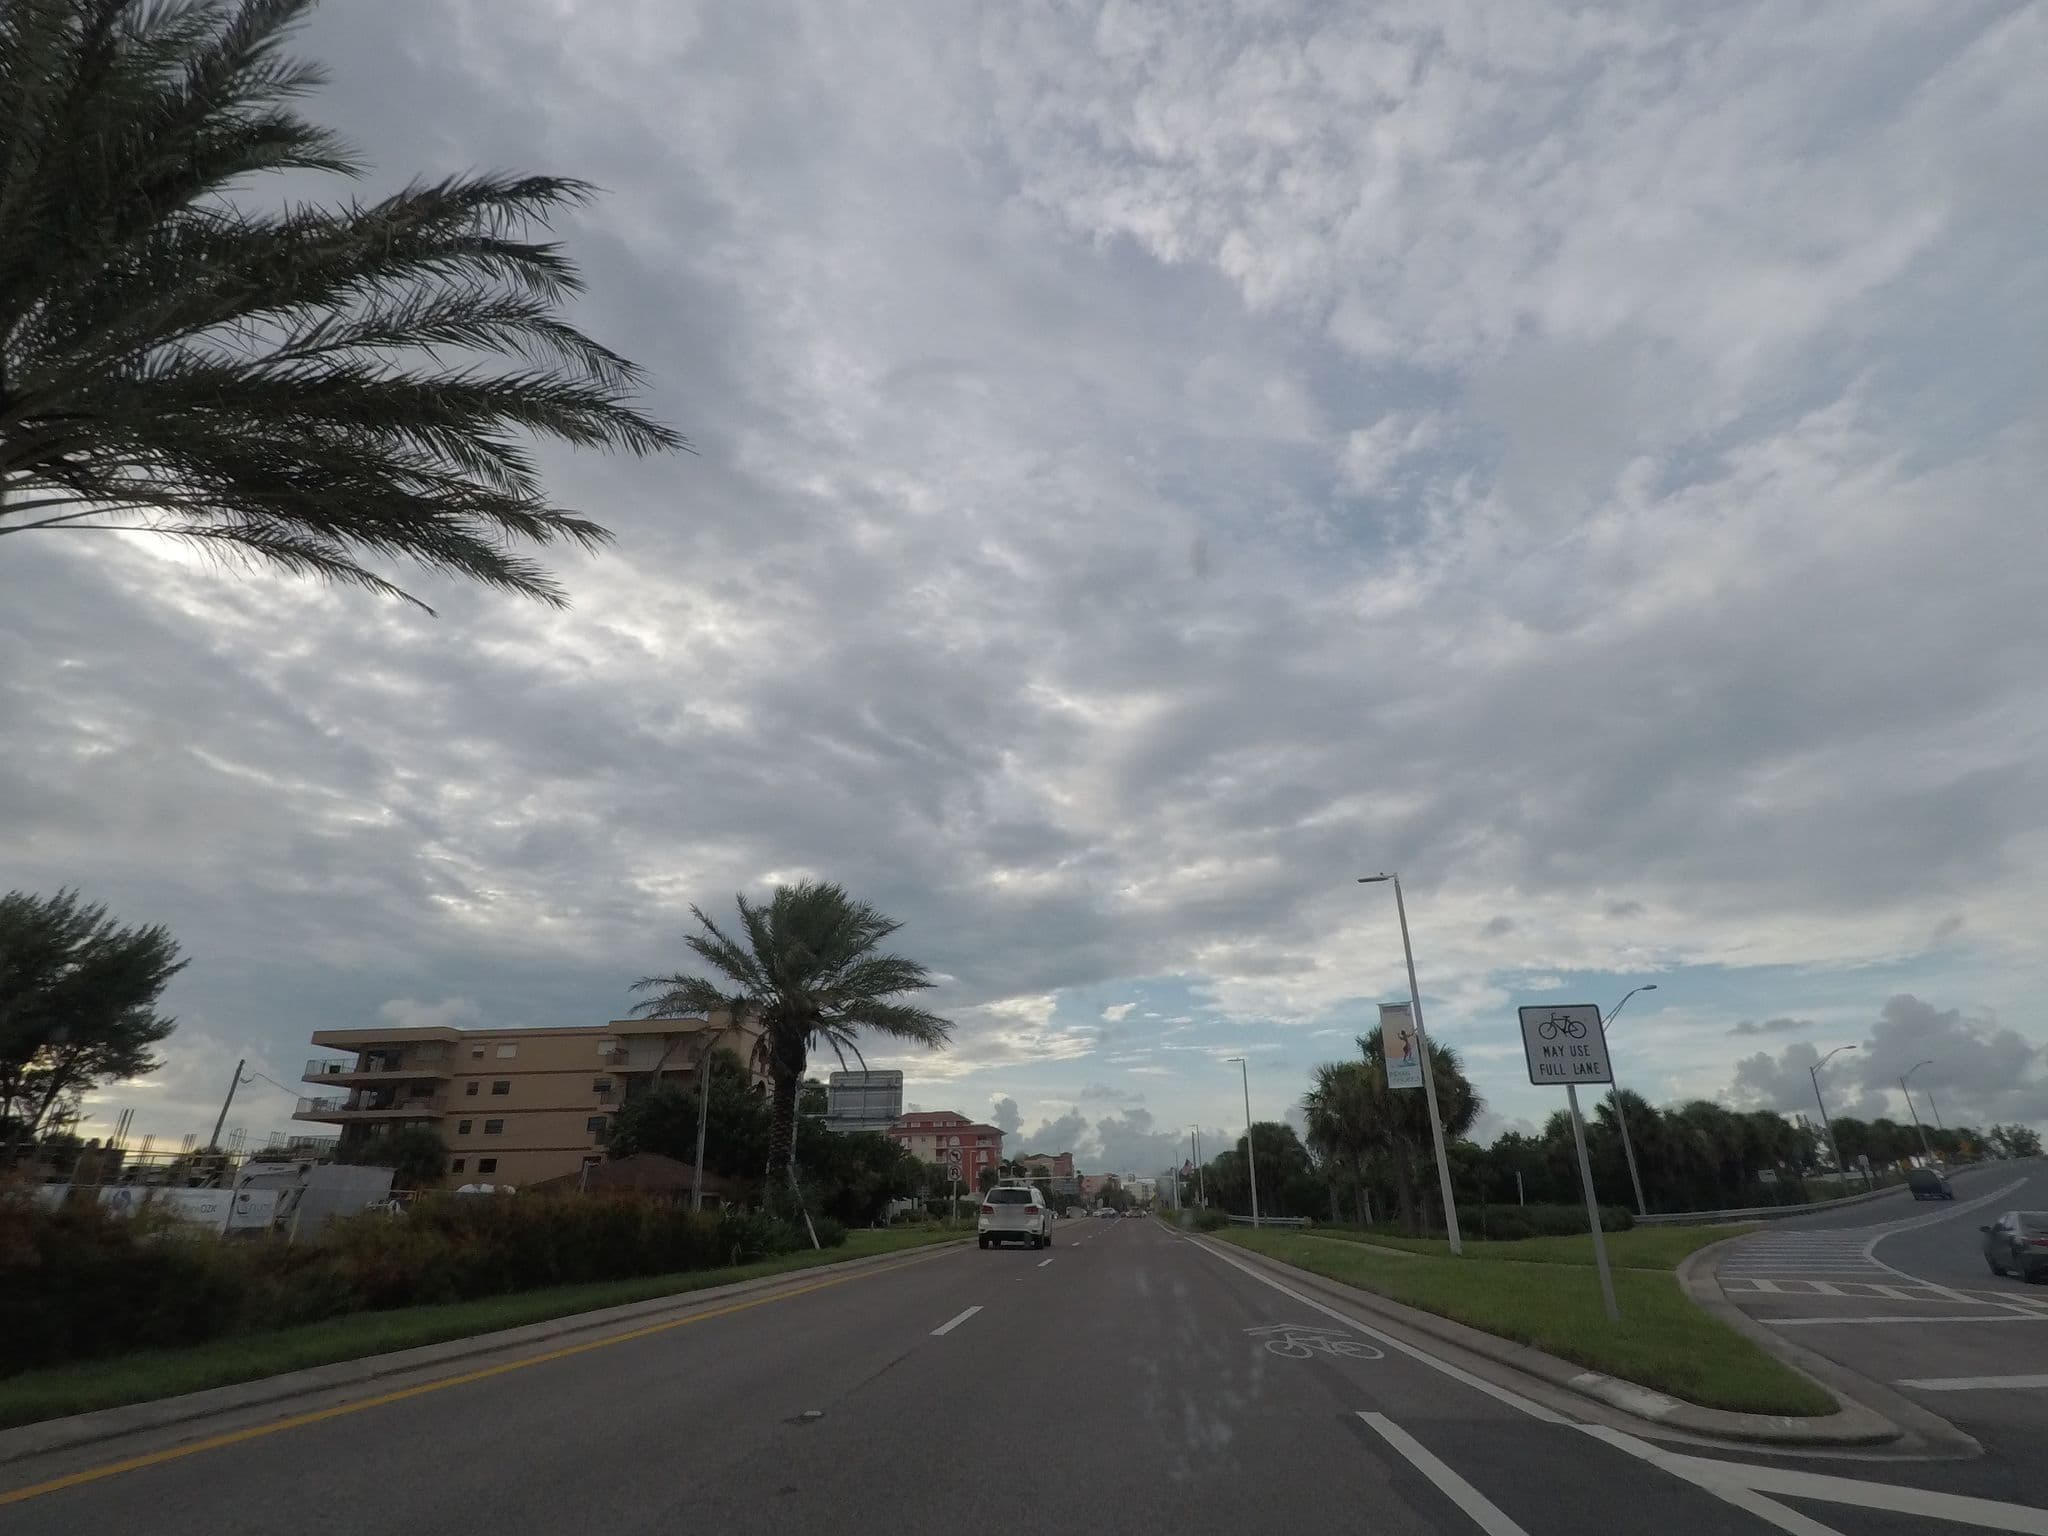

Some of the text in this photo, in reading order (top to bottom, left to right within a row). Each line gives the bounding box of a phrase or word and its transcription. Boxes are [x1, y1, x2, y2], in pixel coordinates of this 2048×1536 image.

[1543, 1045, 1590, 1057] MAY USE
[1540, 1062, 1600, 1075] FULL LANE
